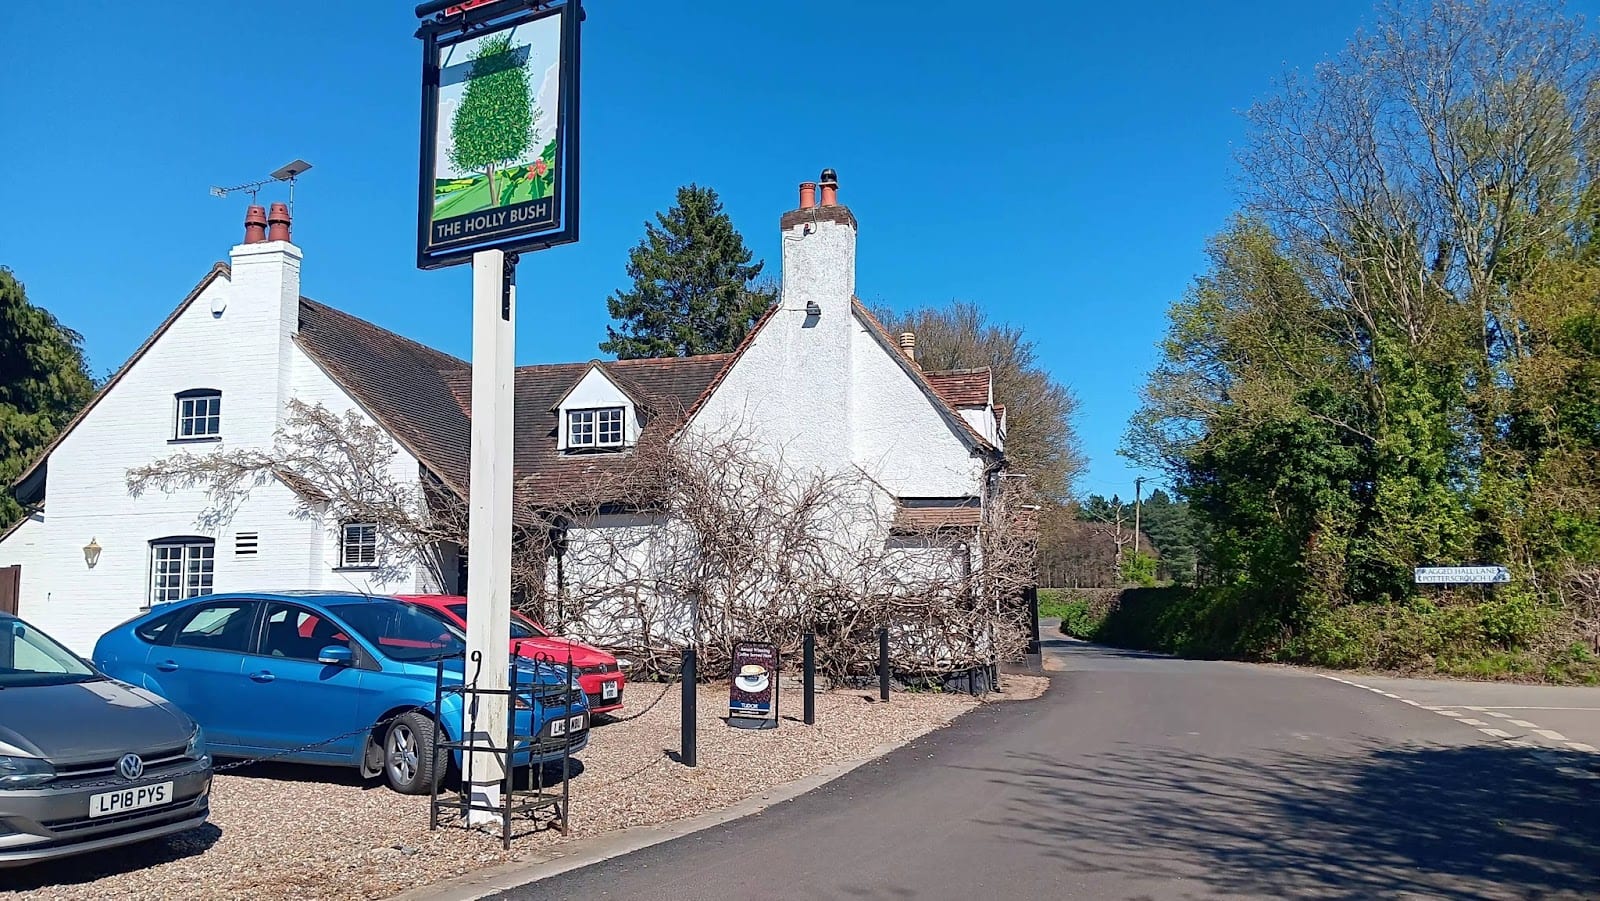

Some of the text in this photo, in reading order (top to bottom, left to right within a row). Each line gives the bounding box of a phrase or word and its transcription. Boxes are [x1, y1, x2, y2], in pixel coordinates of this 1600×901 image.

[437, 203, 547, 238] THE HOLLY BUSH
[1476, 567, 1497, 575] LANE
[100, 785, 164, 812] LP18 PYS
